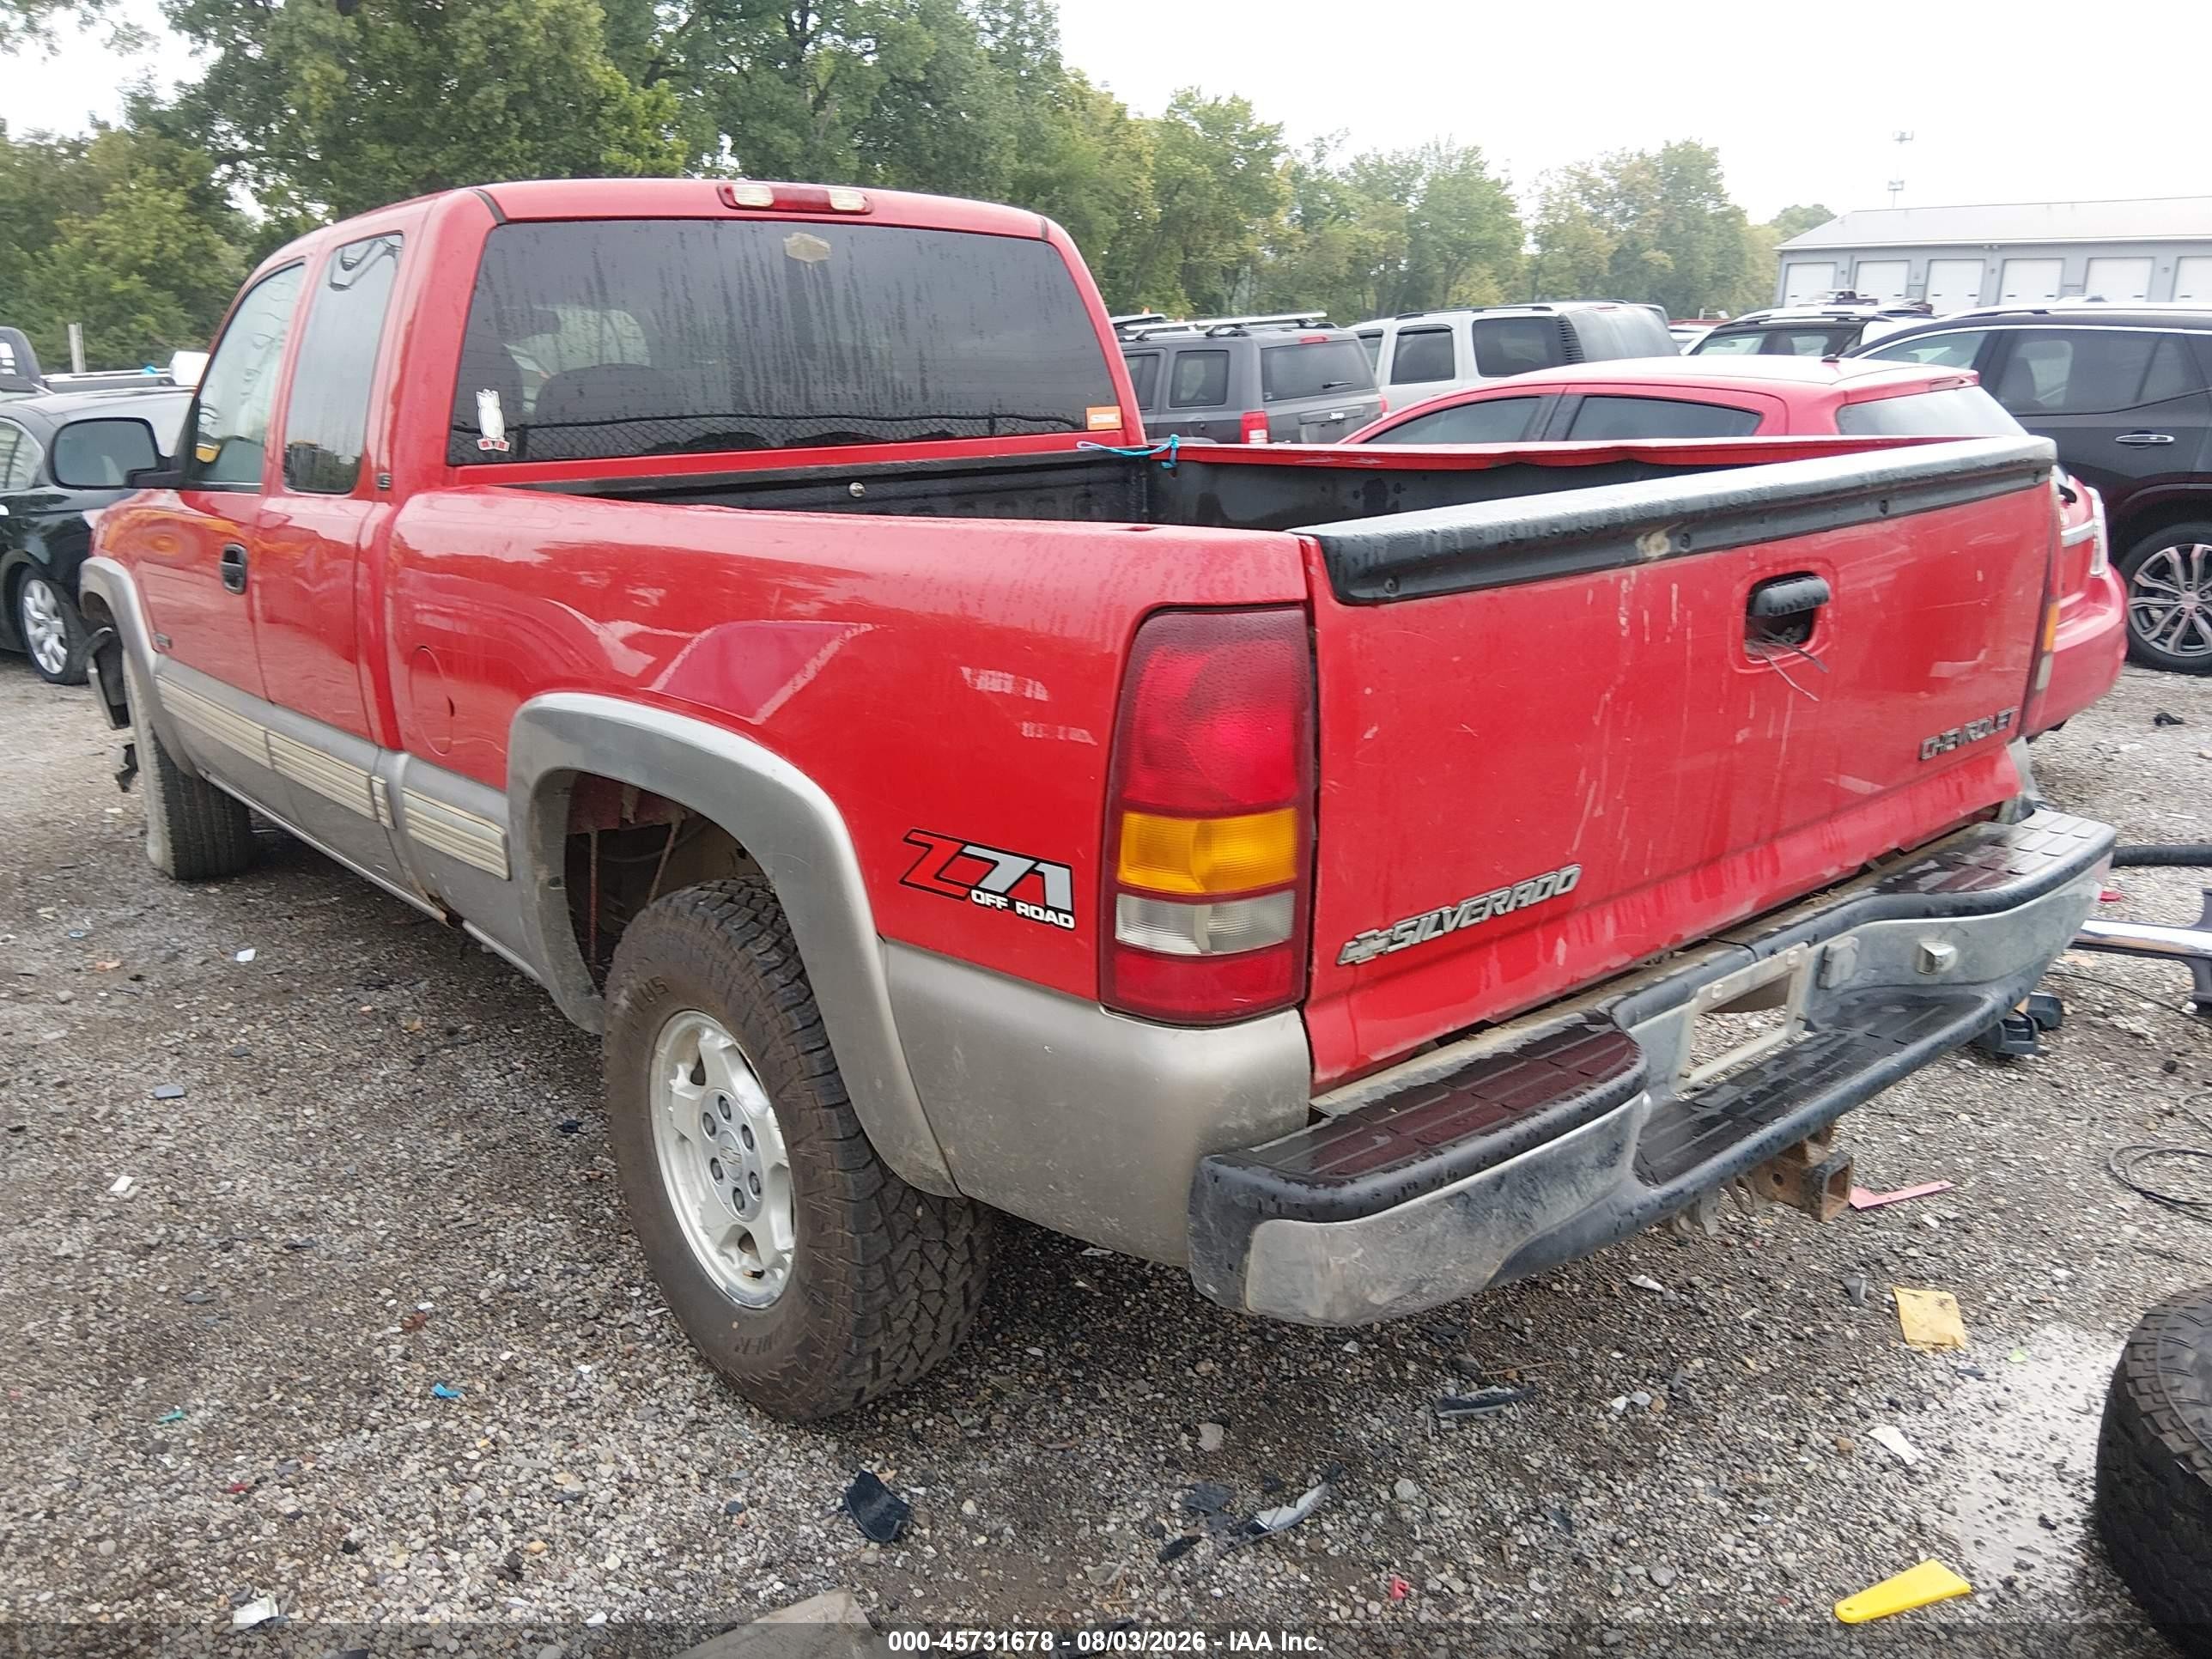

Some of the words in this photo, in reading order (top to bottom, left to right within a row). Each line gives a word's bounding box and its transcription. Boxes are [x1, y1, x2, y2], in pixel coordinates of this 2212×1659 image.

[1919, 706, 2021, 761] CHEVROLET
[900, 828, 1073, 912] Z71
[970, 889, 1008, 909] OFF
[1015, 901, 1075, 929] ROAD
[1387, 863, 1582, 954] SILVERADO
